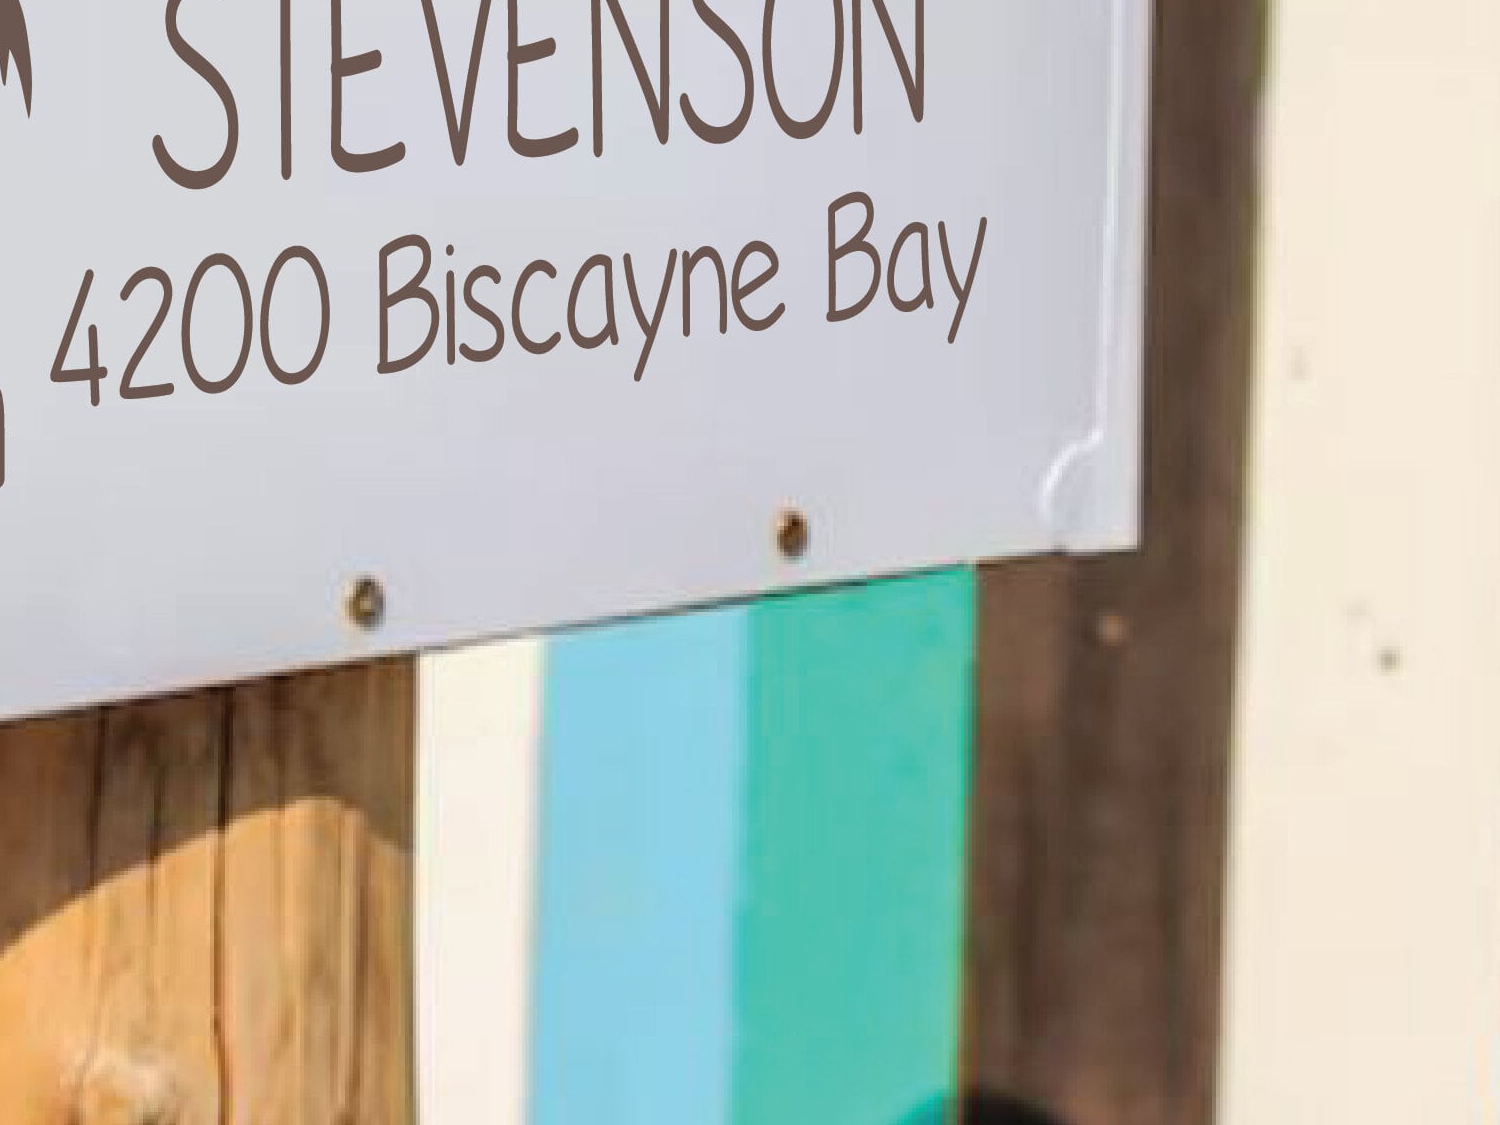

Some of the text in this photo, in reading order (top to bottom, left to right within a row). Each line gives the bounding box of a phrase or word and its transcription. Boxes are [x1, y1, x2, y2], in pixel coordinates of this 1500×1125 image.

[49, 191, 988, 407] 4200 Biscayne Bay
